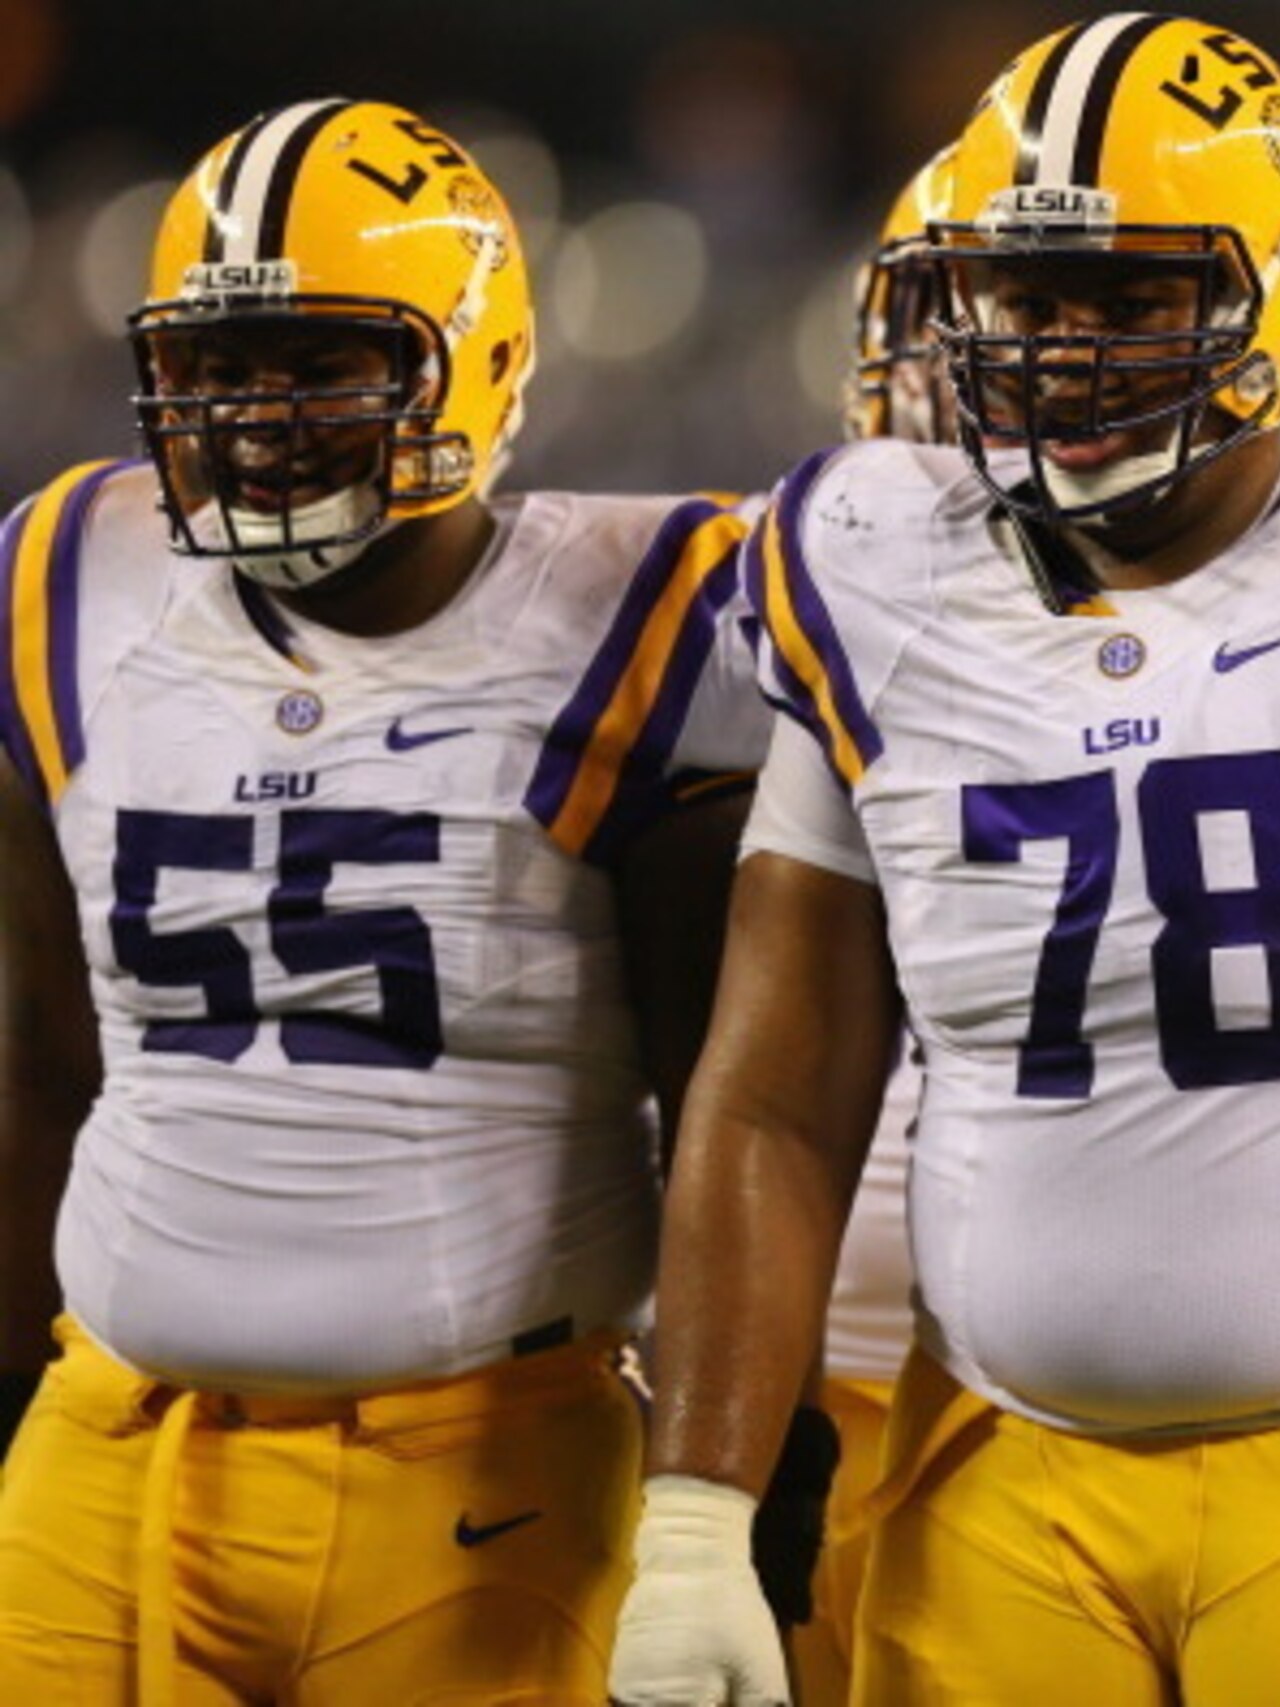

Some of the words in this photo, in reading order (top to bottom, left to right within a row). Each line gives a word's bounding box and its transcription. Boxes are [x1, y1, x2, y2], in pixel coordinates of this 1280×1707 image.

[1159, 34, 1276, 130] LS
[1016, 188, 1083, 212] LSU
[206, 266, 267, 289] LSU
[1083, 717, 1161, 755] LSU
[234, 769, 318, 801] LSU
[108, 807, 446, 1071] 55
